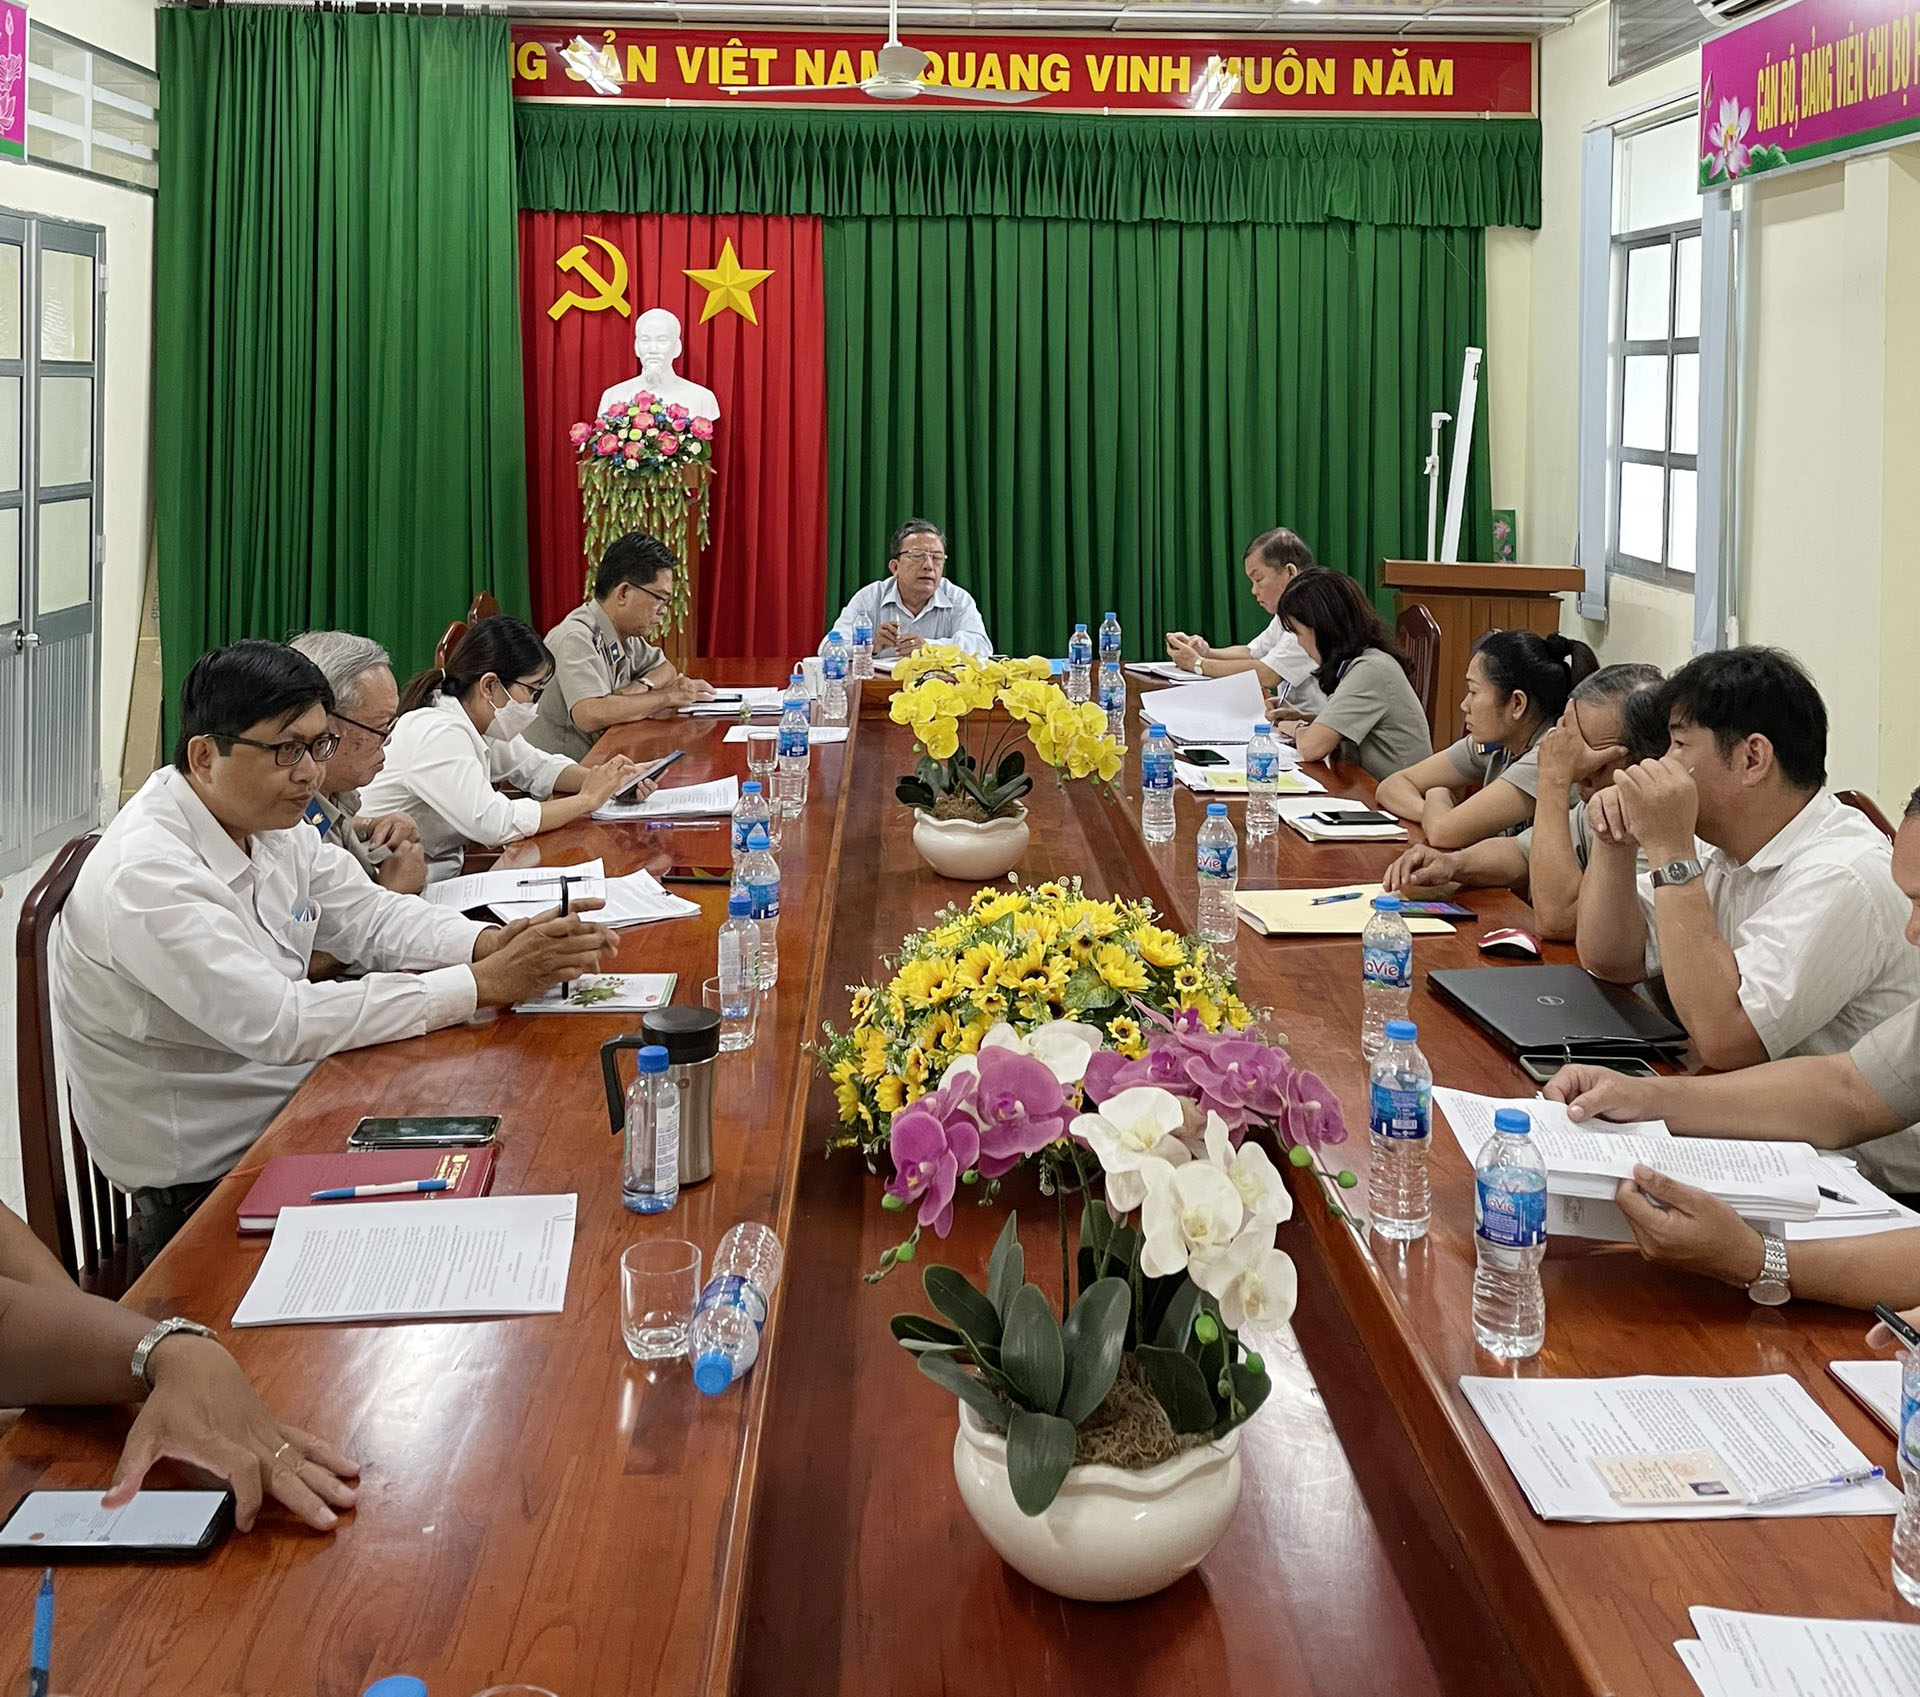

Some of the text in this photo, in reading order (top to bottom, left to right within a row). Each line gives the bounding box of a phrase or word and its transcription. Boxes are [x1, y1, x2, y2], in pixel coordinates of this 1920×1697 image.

[510, 41, 547, 81] G
[676, 38, 777, 96] VIỆT
[919, 50, 1071, 93] QUANG
[1086, 54, 1190, 94] VINH
[1207, 47, 1336, 96] MUÔN
[1352, 48, 1454, 97] NĂM
[1756, 51, 1779, 133] CÁN
[1800, 25, 1833, 119] ĐẢNG
[1835, 20, 1864, 109] VIÊN
[1866, 23, 1889, 100] CHI
